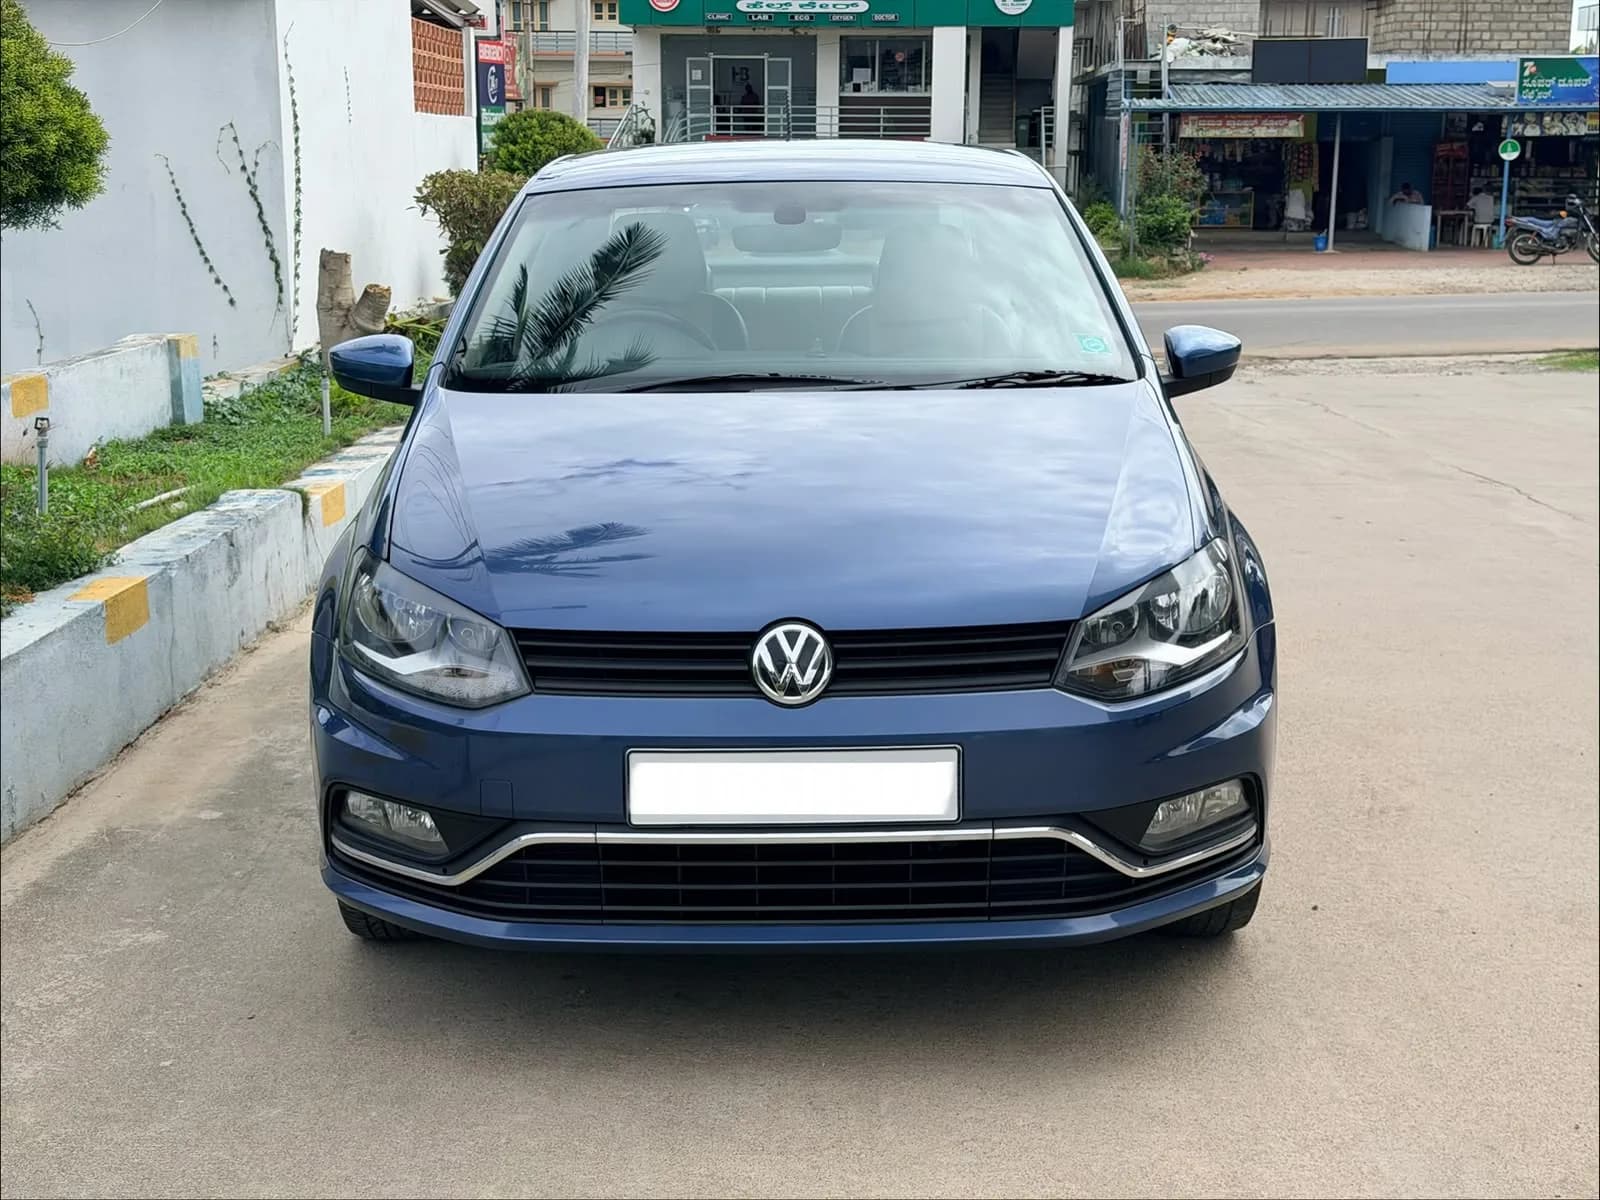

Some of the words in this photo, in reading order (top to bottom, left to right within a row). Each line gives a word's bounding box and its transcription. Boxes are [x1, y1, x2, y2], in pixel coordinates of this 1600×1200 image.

[798, 1, 860, 9] ಕೇರ್
[874, 13, 897, 21] DOCTOR
[753, 623, 832, 705] VW
